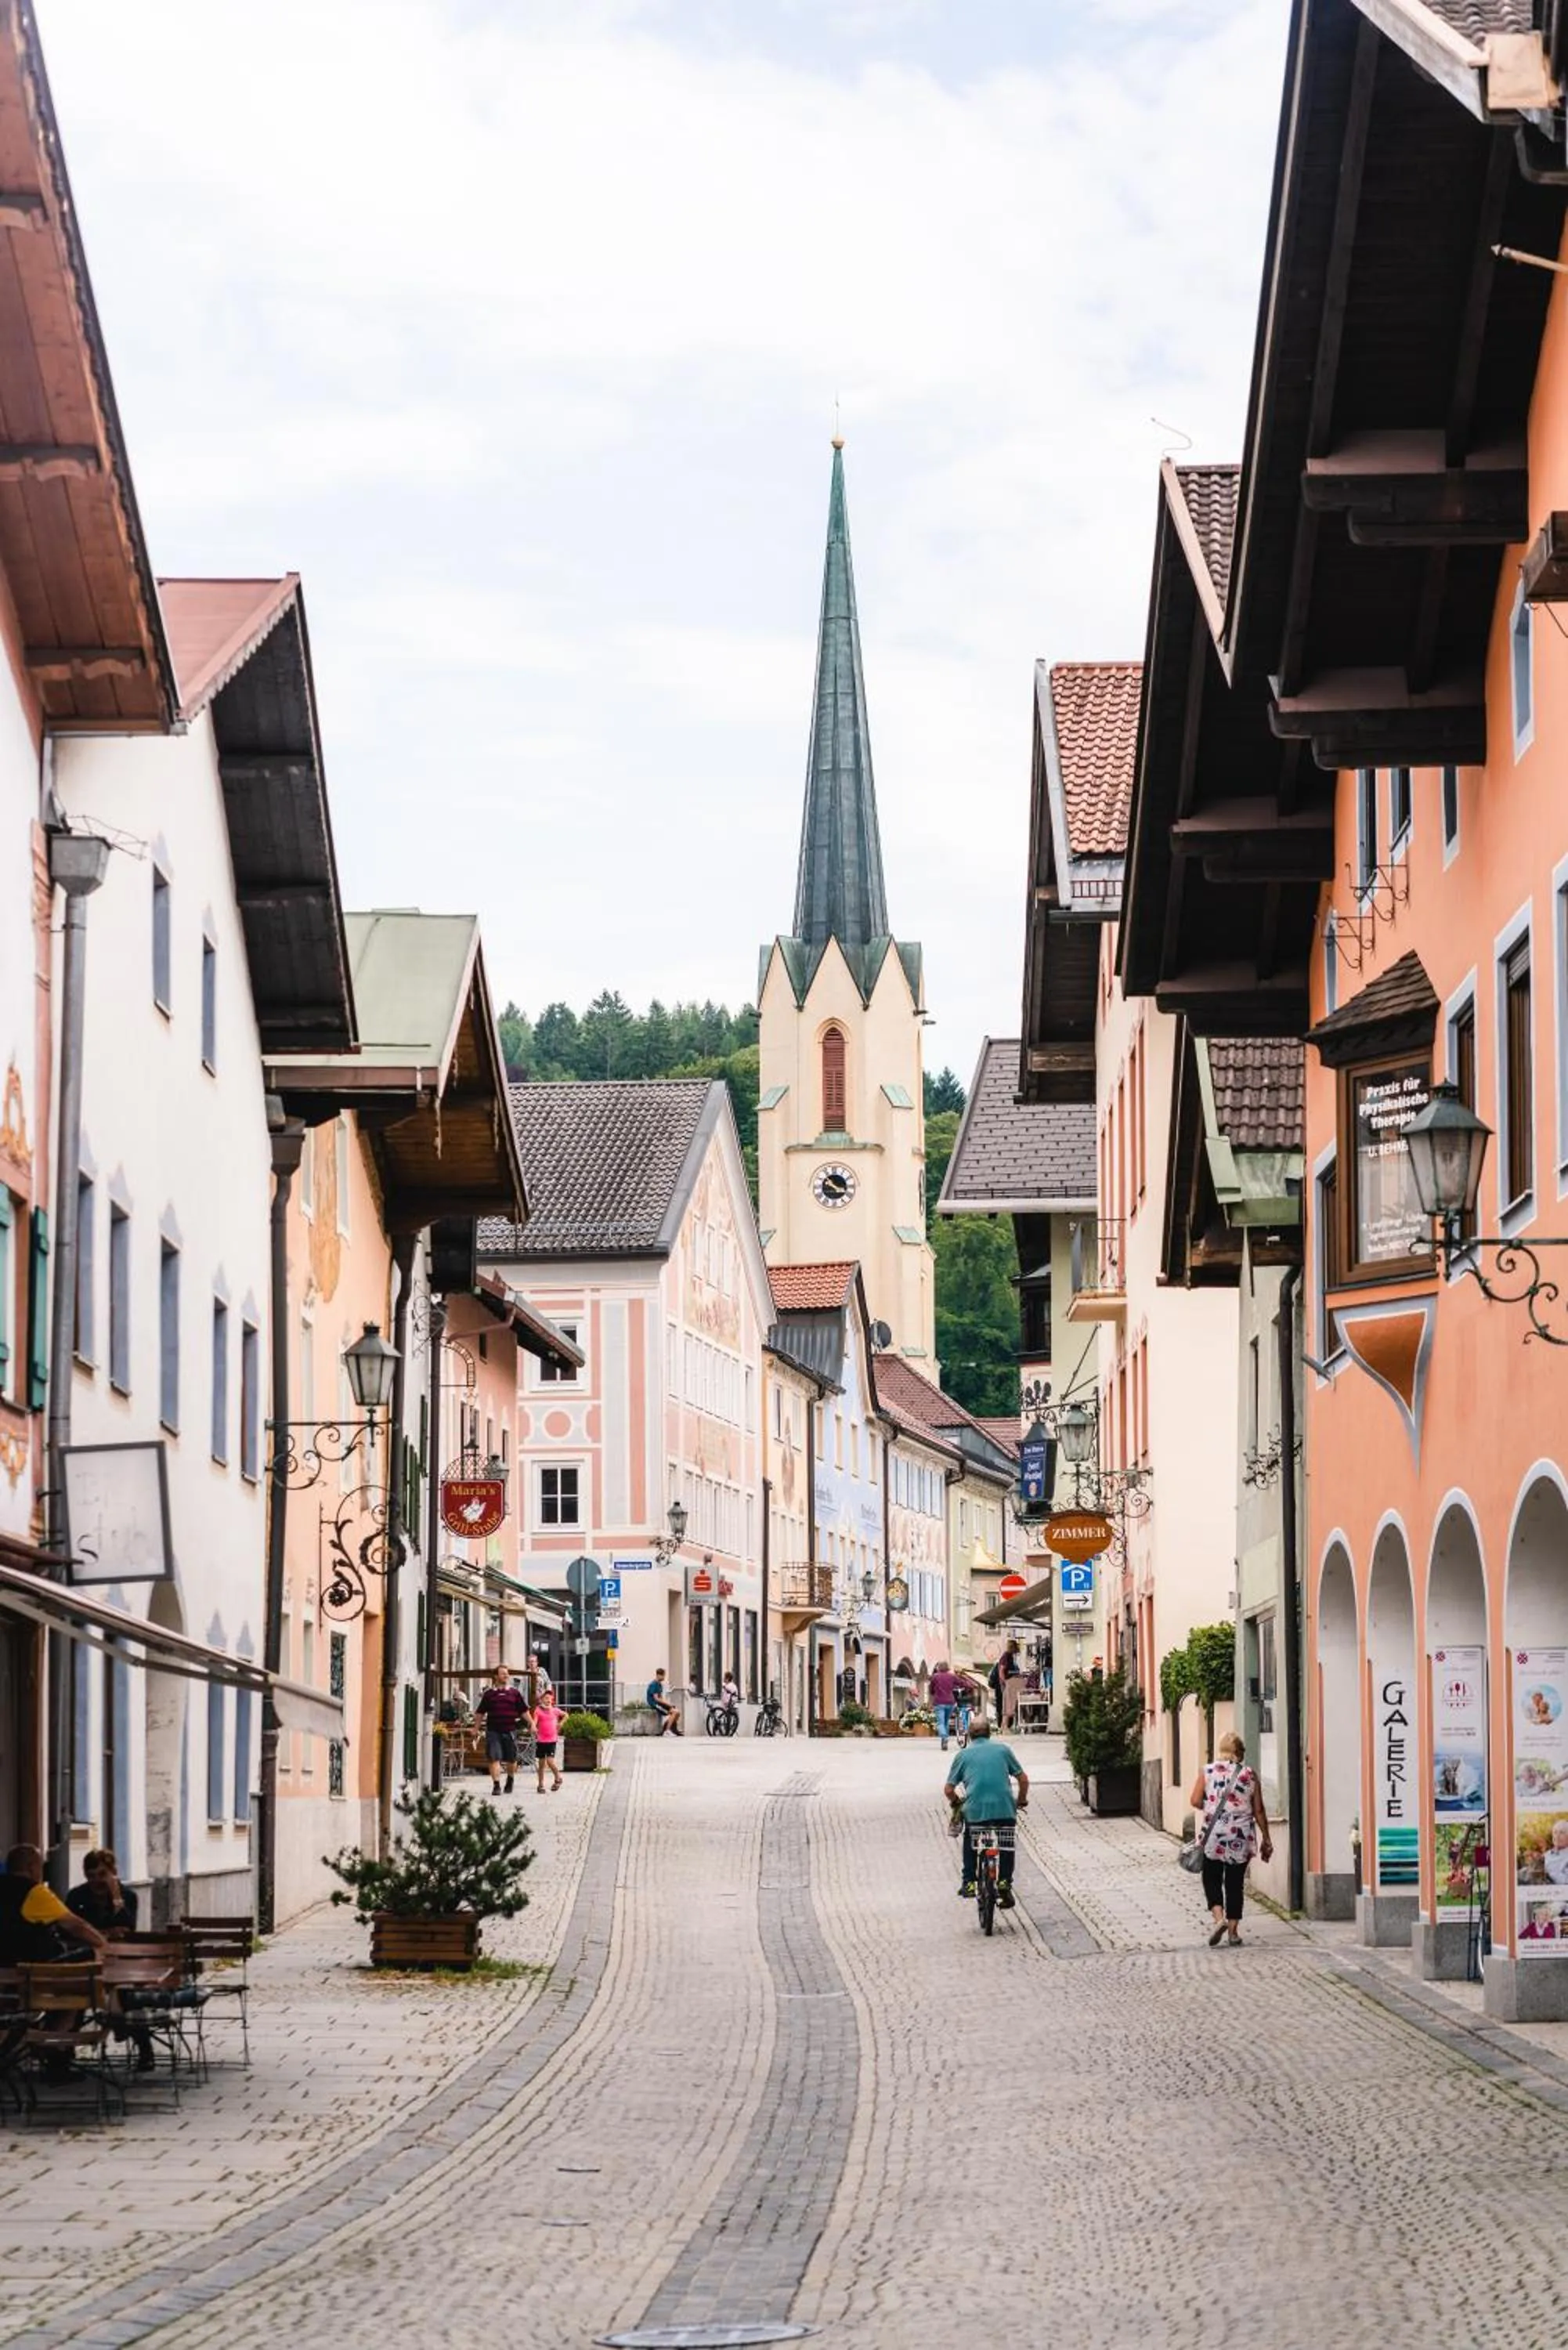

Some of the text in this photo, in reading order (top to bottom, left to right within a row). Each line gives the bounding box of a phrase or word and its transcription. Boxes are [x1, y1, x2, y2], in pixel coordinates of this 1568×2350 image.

[1367, 1078, 1420, 1098] Praxis für
[1359, 1093, 1429, 1116] Physikalische
[1371, 1111, 1416, 1129] Therapie
[450, 1484, 496, 1495] Maria's
[447, 1510, 500, 1535] Grill-Stube
[1052, 1528, 1106, 1539] ZIMMER
[604, 1581, 616, 1596] P
[1071, 1570, 1085, 1589] P
[1382, 1681, 1408, 1817] GALERIE
